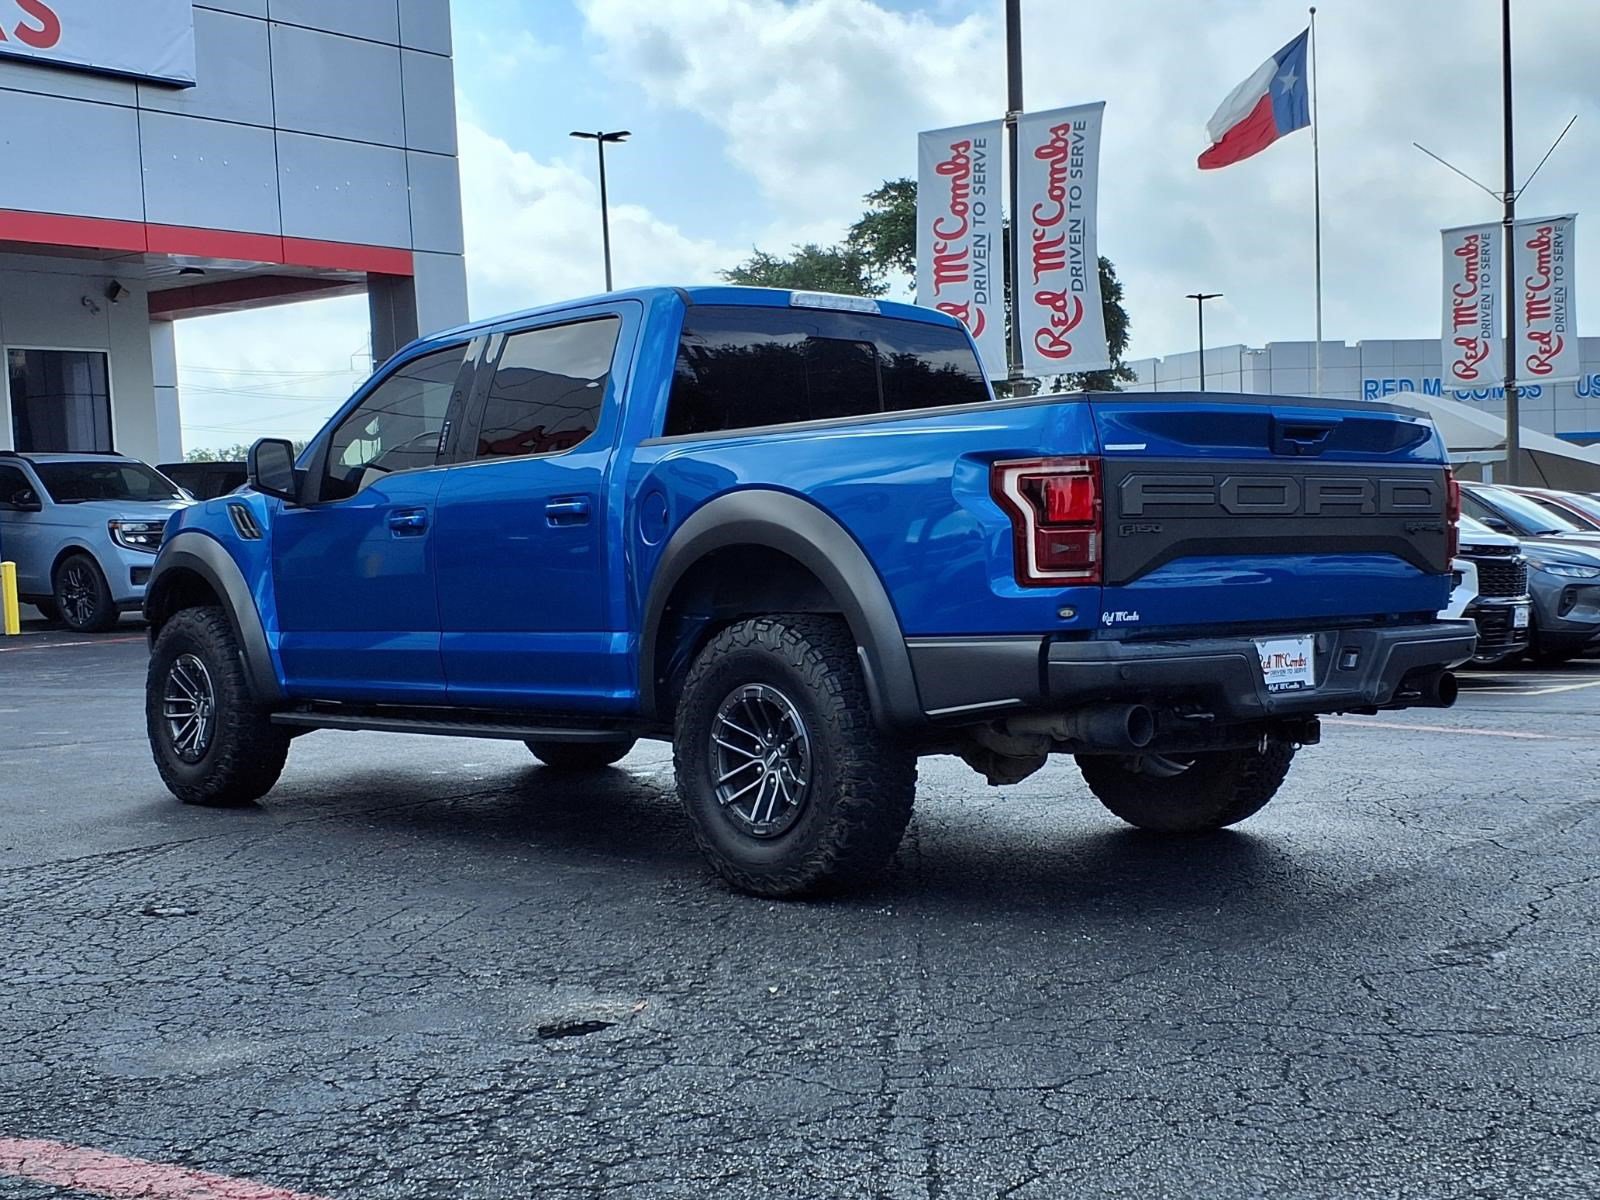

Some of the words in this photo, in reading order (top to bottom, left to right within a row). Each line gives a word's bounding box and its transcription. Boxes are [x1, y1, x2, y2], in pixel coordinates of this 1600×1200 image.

[0, 0, 61, 49] S
[973, 138, 987, 195] SERVE
[1071, 120, 1087, 180] SERVE
[933, 140, 971, 296] McCombs
[973, 202, 986, 227] TO
[1032, 122, 1071, 285] McCombs
[1070, 186, 1082, 212] TO
[1070, 219, 1084, 292] DRIVEN
[1480, 233, 1491, 270] SERVE
[1554, 225, 1564, 262] SERVE
[973, 234, 987, 304] DRIVEN
[1453, 234, 1479, 333] McCombs
[1481, 273, 1491, 290] TO
[1525, 226, 1553, 328] McCombs
[1554, 266, 1564, 282] TO
[1034, 288, 1083, 359] Red
[1480, 295, 1491, 339] DRIVEN
[1554, 288, 1565, 333] DRIVEN
[1452, 336, 1489, 380] Red
[1526, 330, 1564, 375] Red
[1363, 378, 1415, 400] RED
[1118, 472, 1442, 518] FORD
[1273, 652, 1306, 668] McCombs
